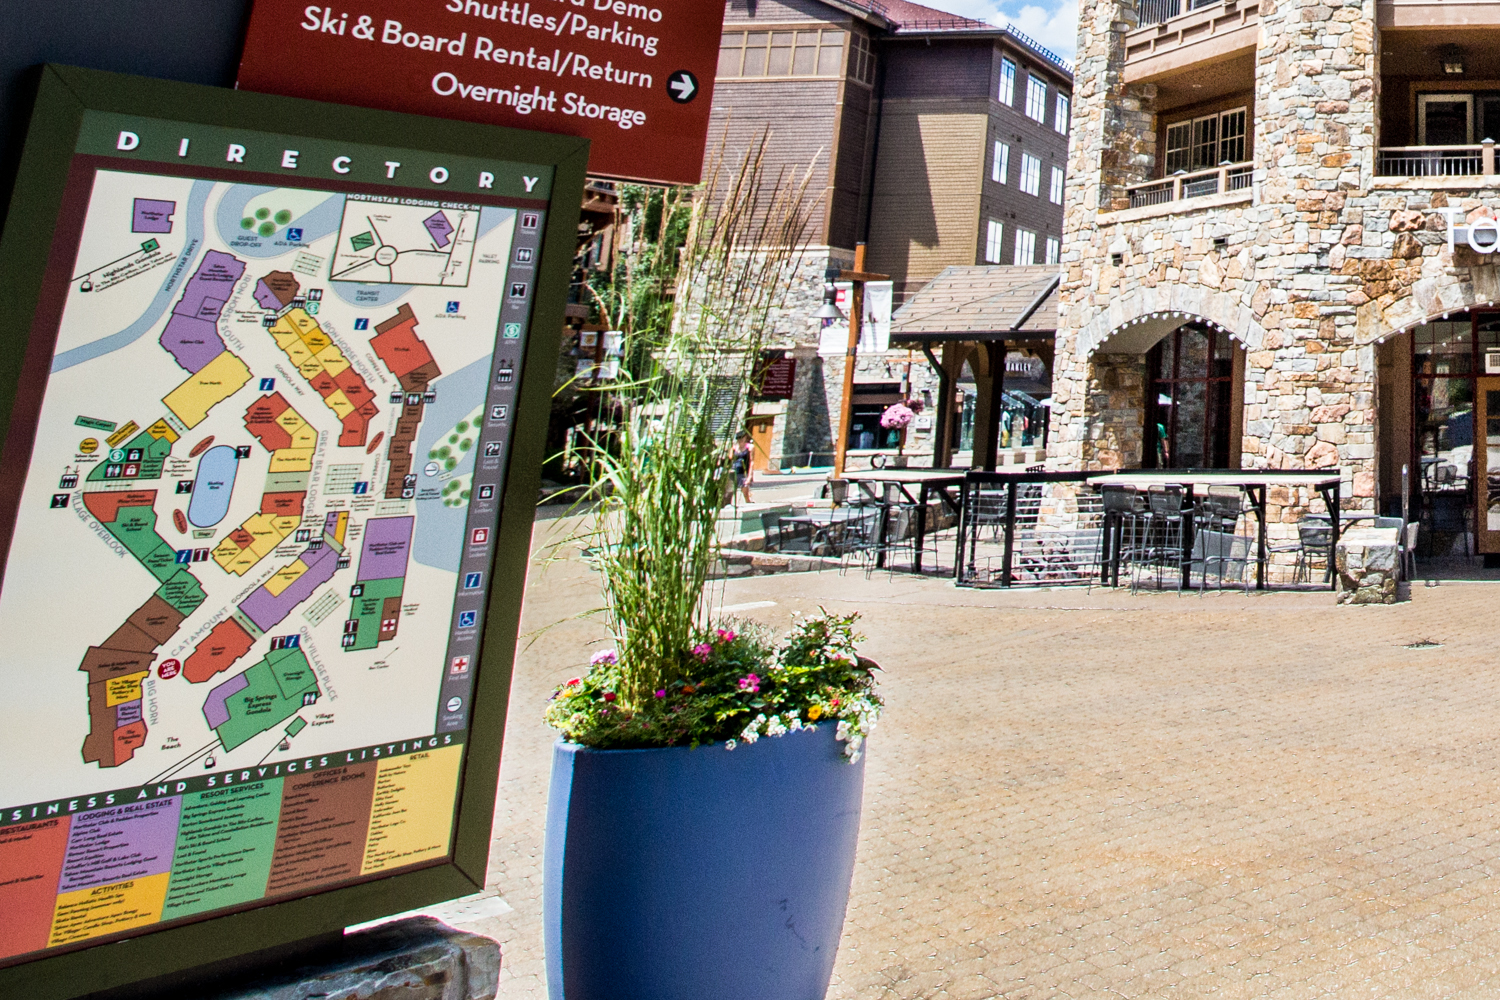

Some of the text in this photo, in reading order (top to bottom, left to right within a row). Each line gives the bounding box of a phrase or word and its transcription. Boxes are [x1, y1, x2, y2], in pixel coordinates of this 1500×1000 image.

[300, 6, 653, 89] Ski & Board Rental/Return
[432, 72, 646, 129] Overnight Storage
[117, 130, 540, 195] DIRECTORY
[347, 194, 480, 211] NORTHSTAR LODGING CHECK-IN
[162, 660, 176, 669] YOU
[164, 665, 175, 673] ARE
[162, 671, 177, 679] HERE
[0, 794, 116, 821] SINESS
[137, 782, 187, 799] AND
[207, 757, 328, 787] SERVICES
[346, 734, 453, 762] LISTINGS
[201, 782, 264, 800] RESORT SERVICES
[78, 809, 115, 821] LODGING
[124, 804, 144, 813] REAL
[146, 799, 173, 809] ESTATE
[91, 881, 134, 895] ACTIVITIES
